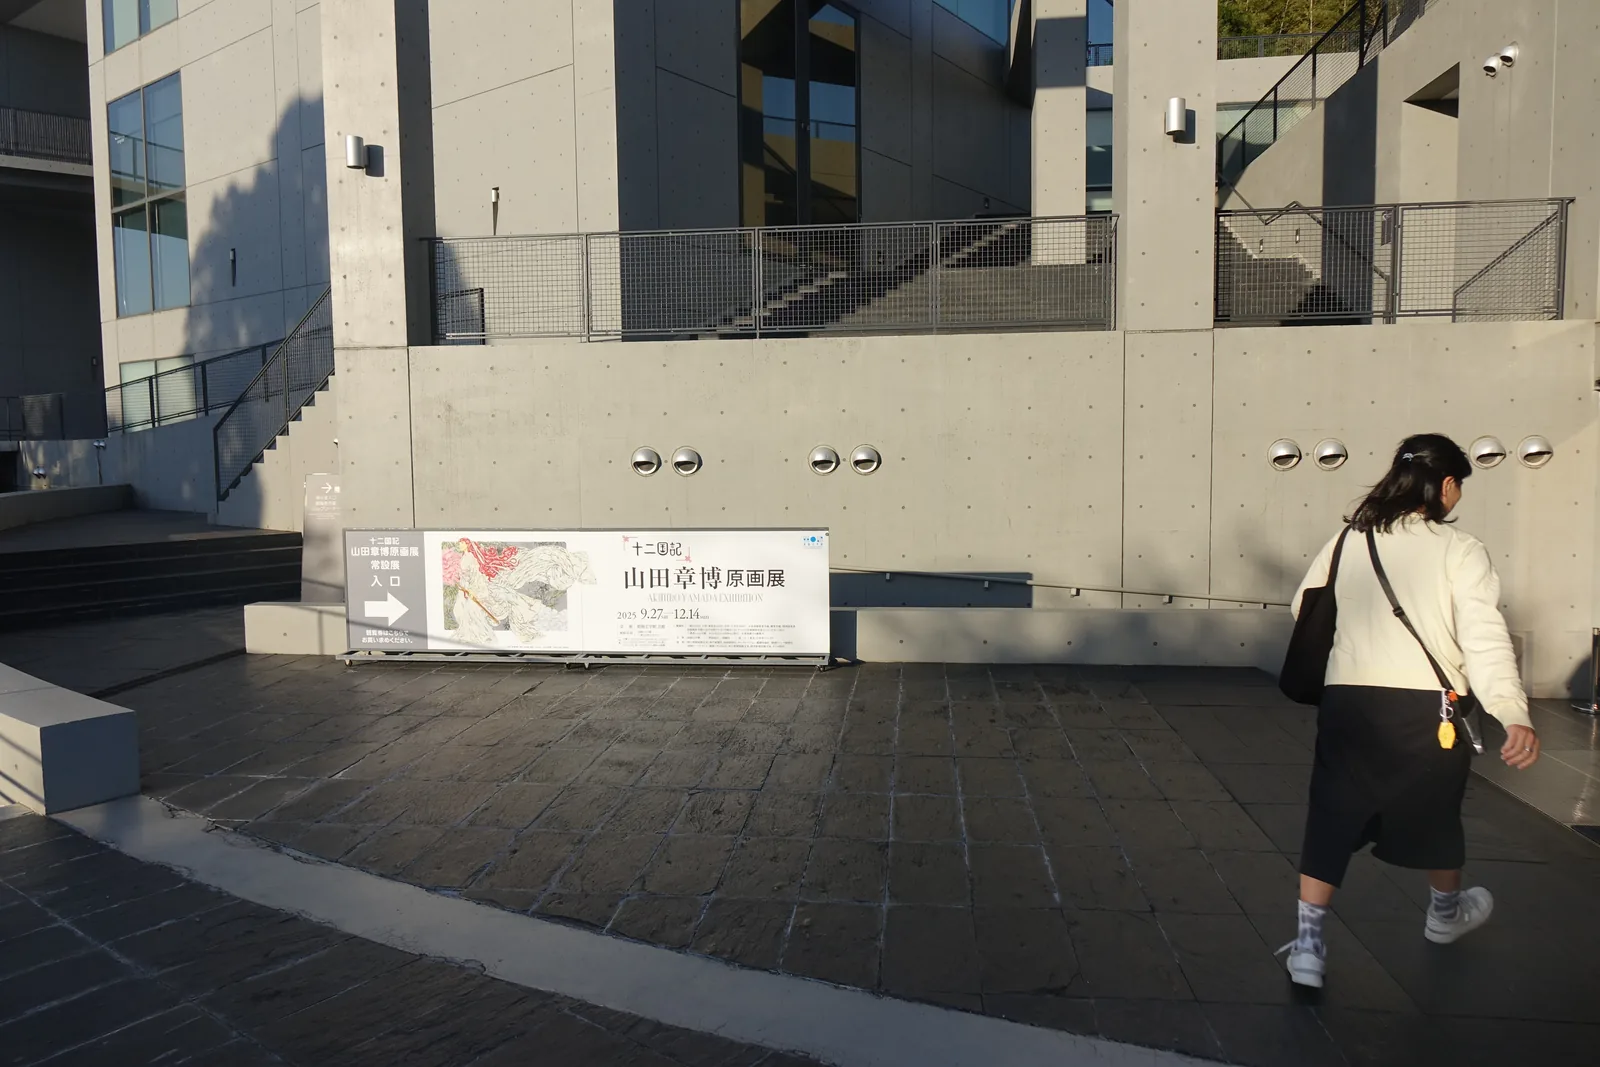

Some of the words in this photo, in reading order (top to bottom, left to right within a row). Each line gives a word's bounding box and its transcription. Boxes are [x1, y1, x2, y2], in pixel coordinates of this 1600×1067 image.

[351, 547, 419, 557] 山田章博原画展
[370, 560, 400, 570] 常設展
[371, 575, 400, 587] 入口
[617, 611, 637, 620] 2025
